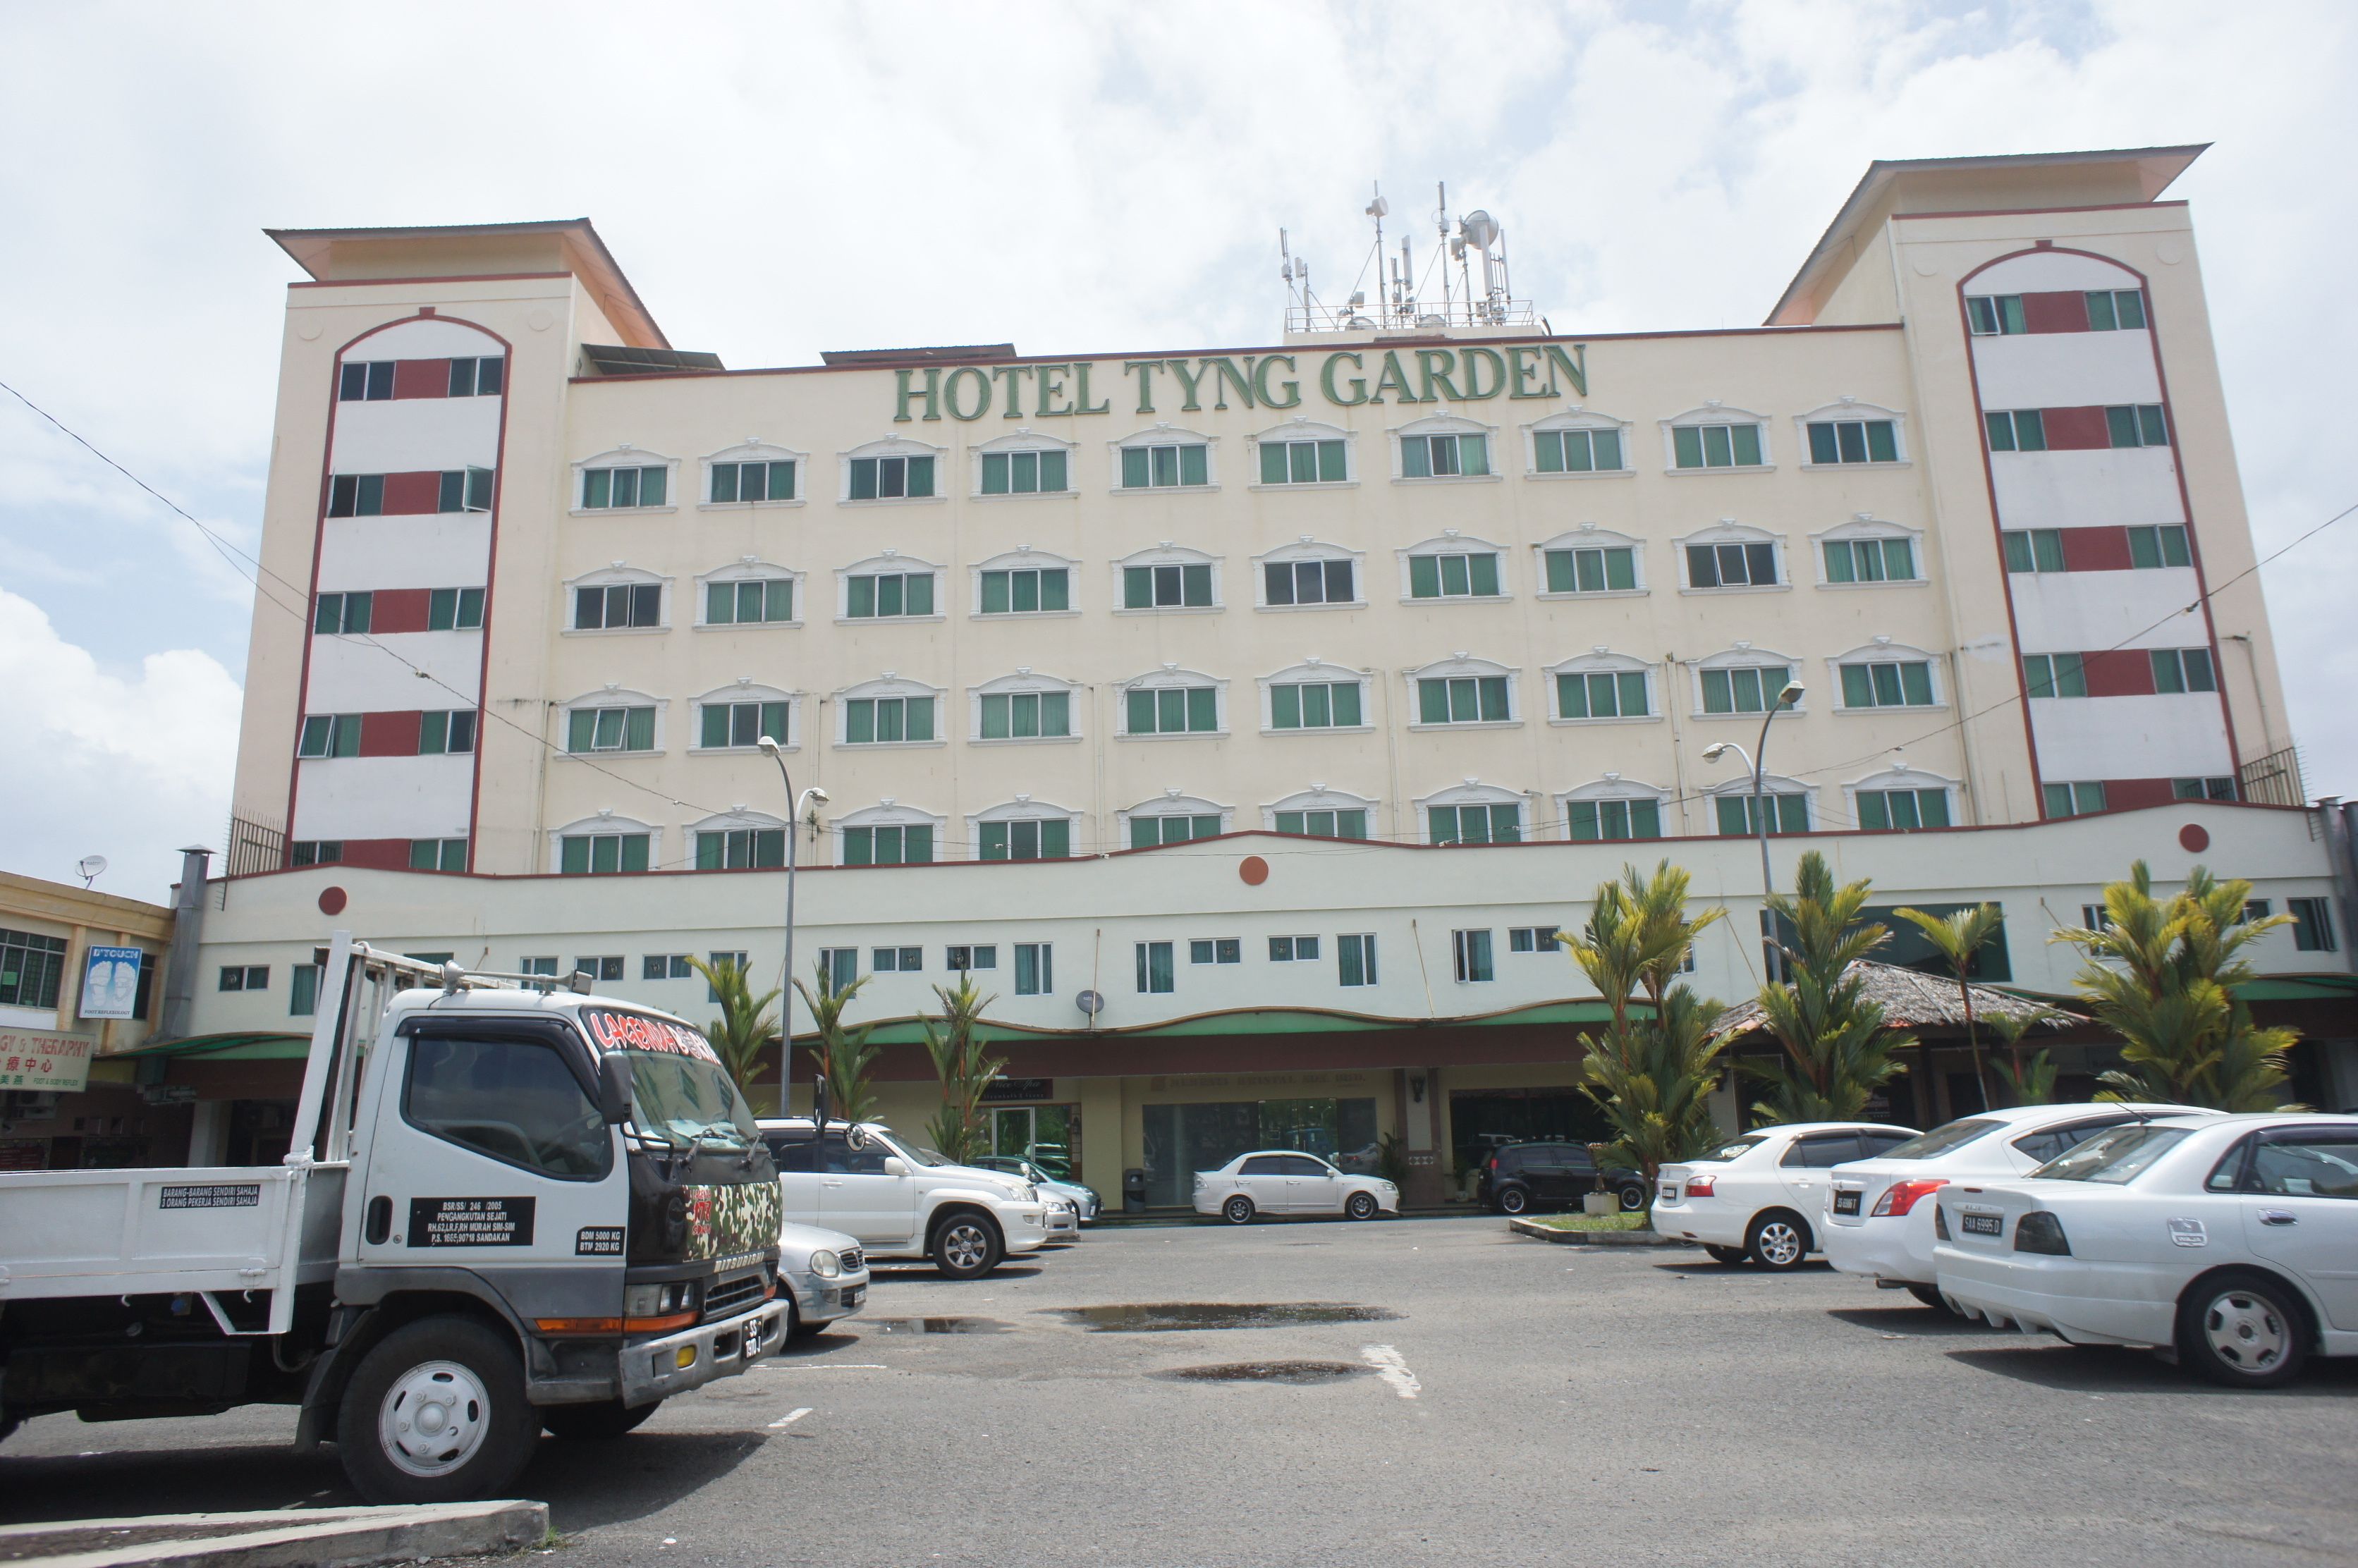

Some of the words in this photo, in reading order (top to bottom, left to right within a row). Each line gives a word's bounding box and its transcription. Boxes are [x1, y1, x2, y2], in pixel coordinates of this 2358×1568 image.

[893, 362, 1110, 422] HOTEL
[1124, 355, 1302, 412] TYNG
[1320, 343, 1589, 407] GARDEN
[93, 948, 139, 959] D'TOUCH
[19, 1038, 27, 1053] &
[31, 1037, 90, 1058] THERAPHY
[0, 1056, 52, 1072] 療中心
[163, 1187, 212, 1197] BARANG-BARANG
[213, 1187, 236, 1196] SENDIRI
[236, 1186, 258, 1196] SAHAJA
[161, 1199, 166, 1208] 3
[166, 1198, 187, 1208] ORANG
[188, 1197, 212, 1207] PEKERJA
[212, 1197, 236, 1206] SENDIRI
[236, 1196, 257, 1206] SAHAJA
[443, 1201, 466, 1211] BSR/SS/
[470, 1201, 481, 1211] 246
[486, 1201, 502, 1211] /2005
[437, 1212, 485, 1221] PENGANGKUTAN
[487, 1211, 507, 1220] SEJATI
[492, 1222, 515, 1231] SIM-SIM
[1965, 1217, 1976, 1230] SAA
[1977, 1218, 1994, 1232] 6995
[1994, 1220, 2000, 1233] D
[432, 1234, 442, 1242] P.S.
[477, 1232, 510, 1242] SANDAKAN
[581, 1231, 594, 1240] BDM
[595, 1231, 610, 1240] 5000
[611, 1231, 621, 1240] KG
[580, 1242, 593, 1251] BTM
[594, 1242, 609, 1251] 2920
[610, 1242, 620, 1251] KG
[714, 1251, 764, 1273] MITSUBISHI
[750, 1319, 757, 1337] SS
[757, 1335, 761, 1352] J
